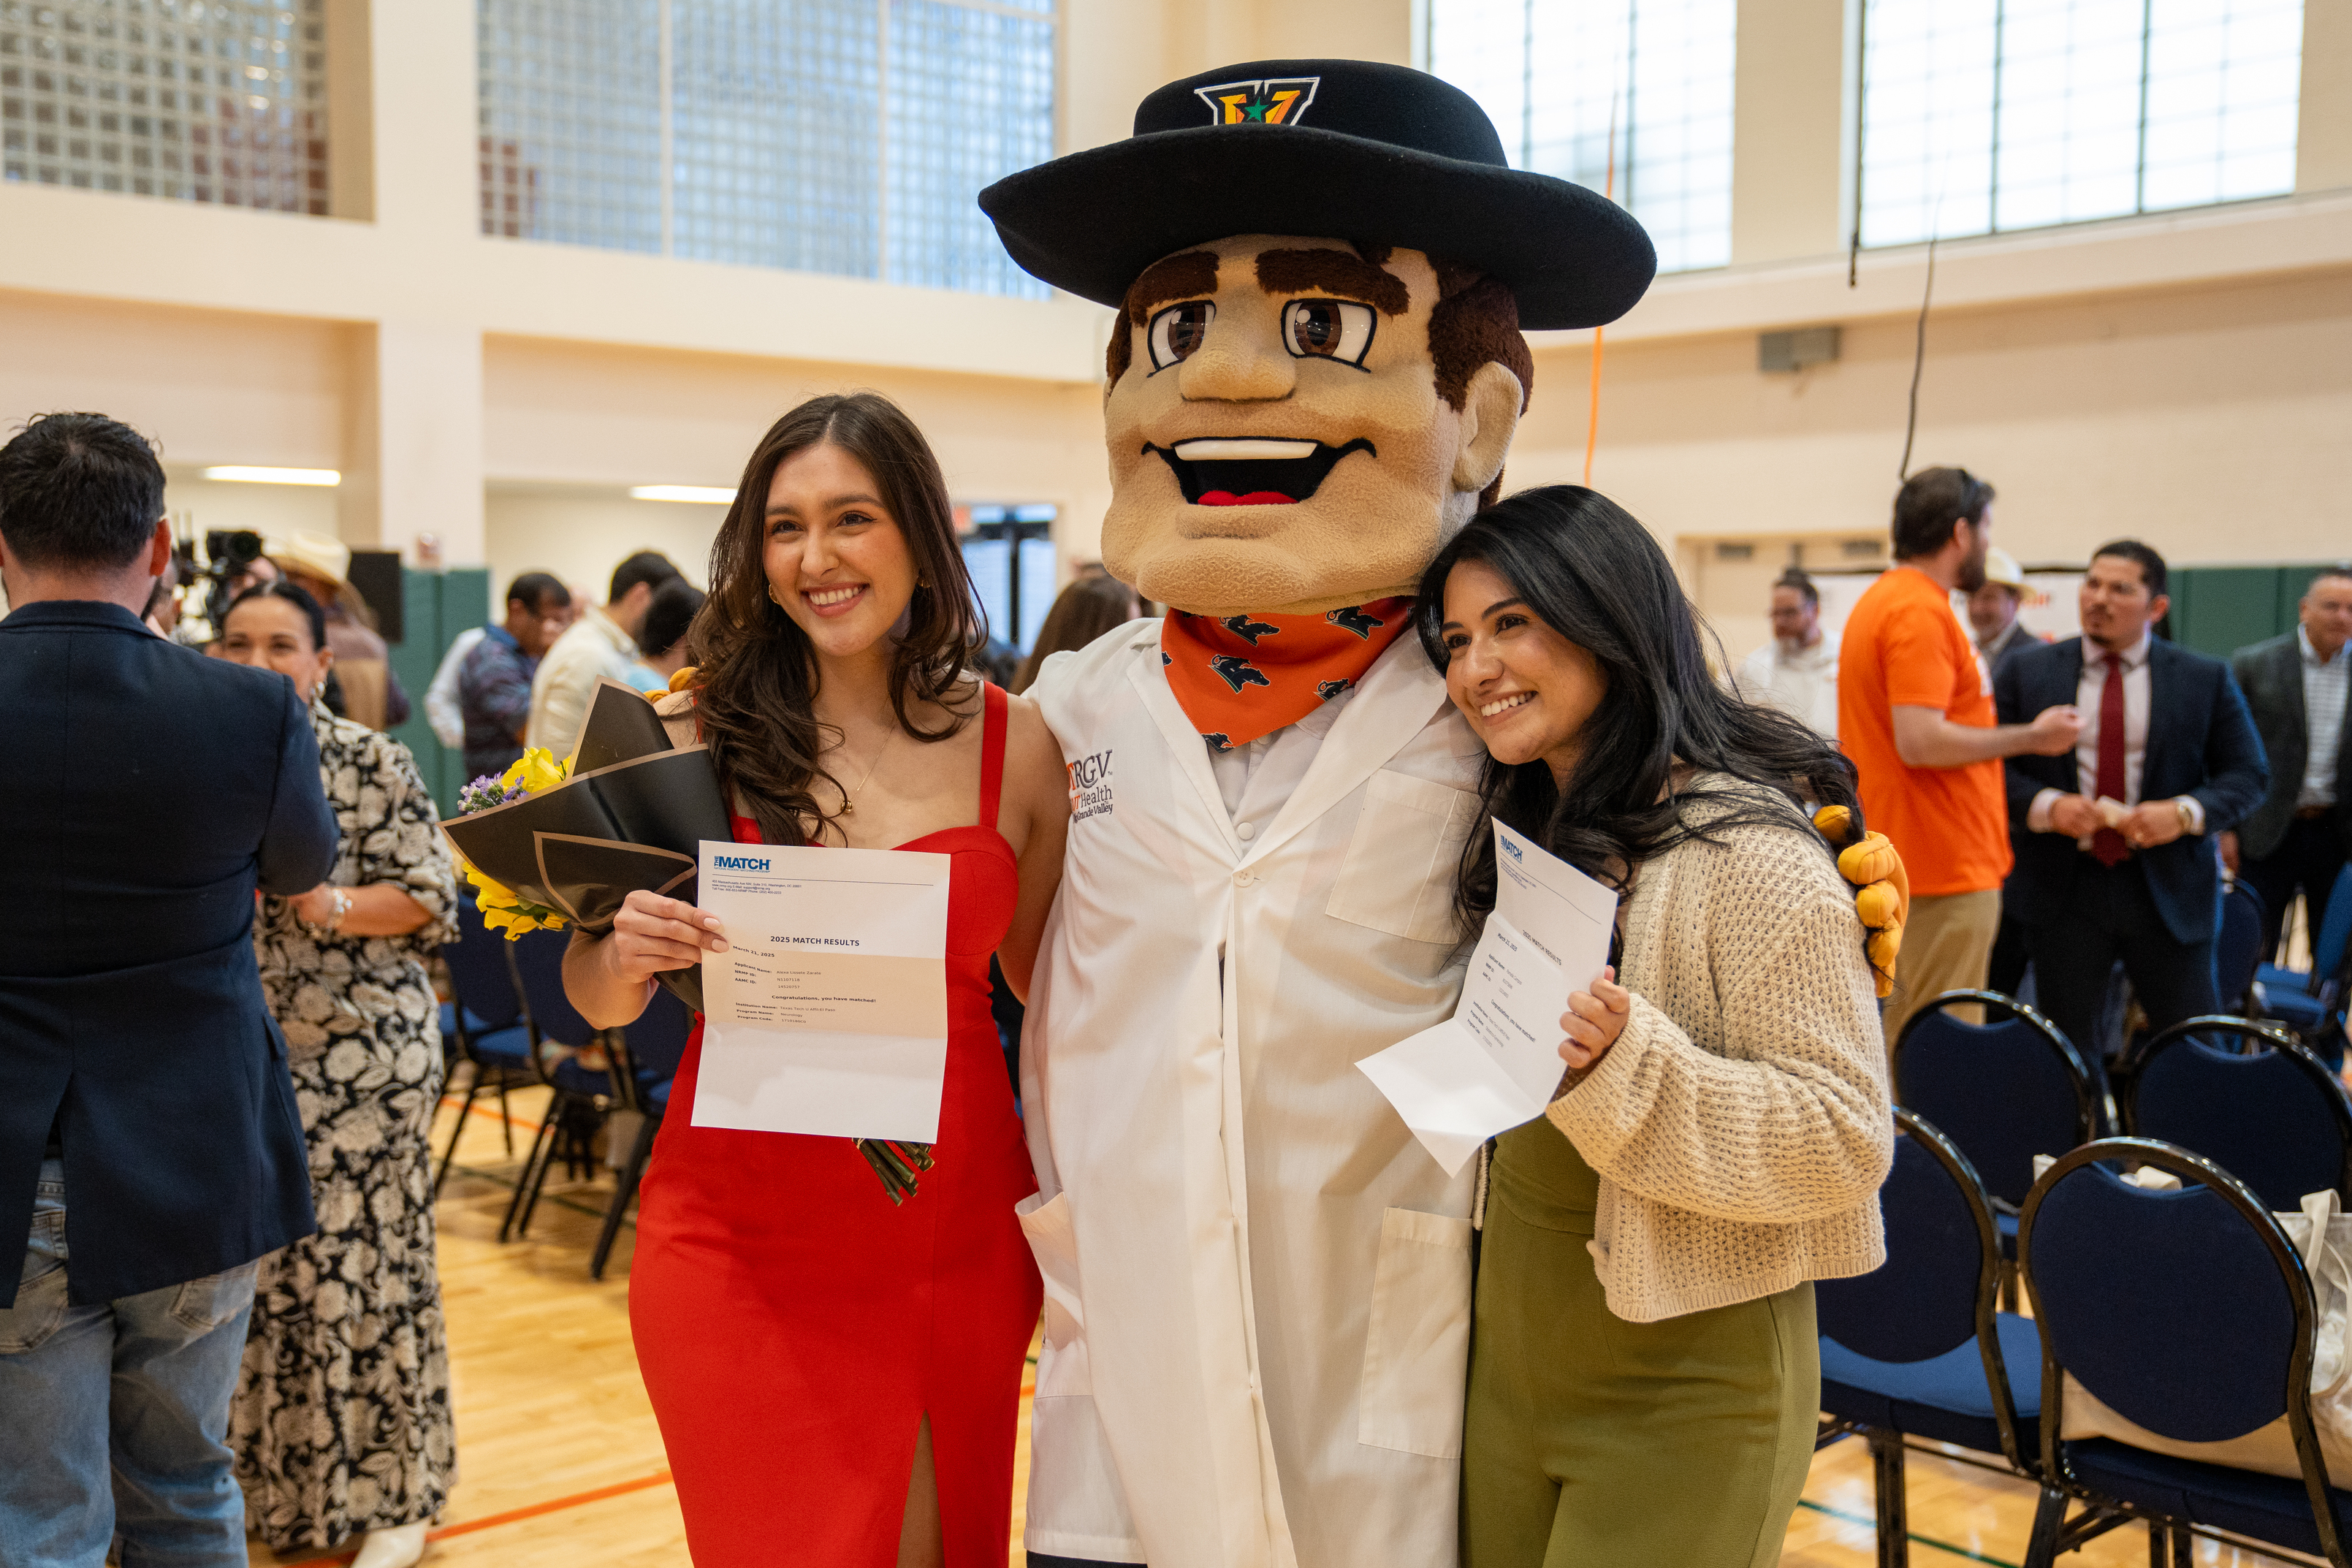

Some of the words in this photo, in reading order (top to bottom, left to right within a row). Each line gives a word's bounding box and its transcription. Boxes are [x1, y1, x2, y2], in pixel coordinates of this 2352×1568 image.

[1094, 804, 1113, 815] Valley
[1502, 836, 1523, 861] MATCH
[719, 856, 769, 870] MATCH
[793, 937, 821, 945] MATCH
[824, 938, 860, 946] RESULTS
[1498, 932, 1506, 942] March
[733, 945, 750, 954] March
[1531, 937, 1545, 952] MATCH
[1545, 948, 1561, 965] RESULTS
[734, 962, 756, 970] Applicant
